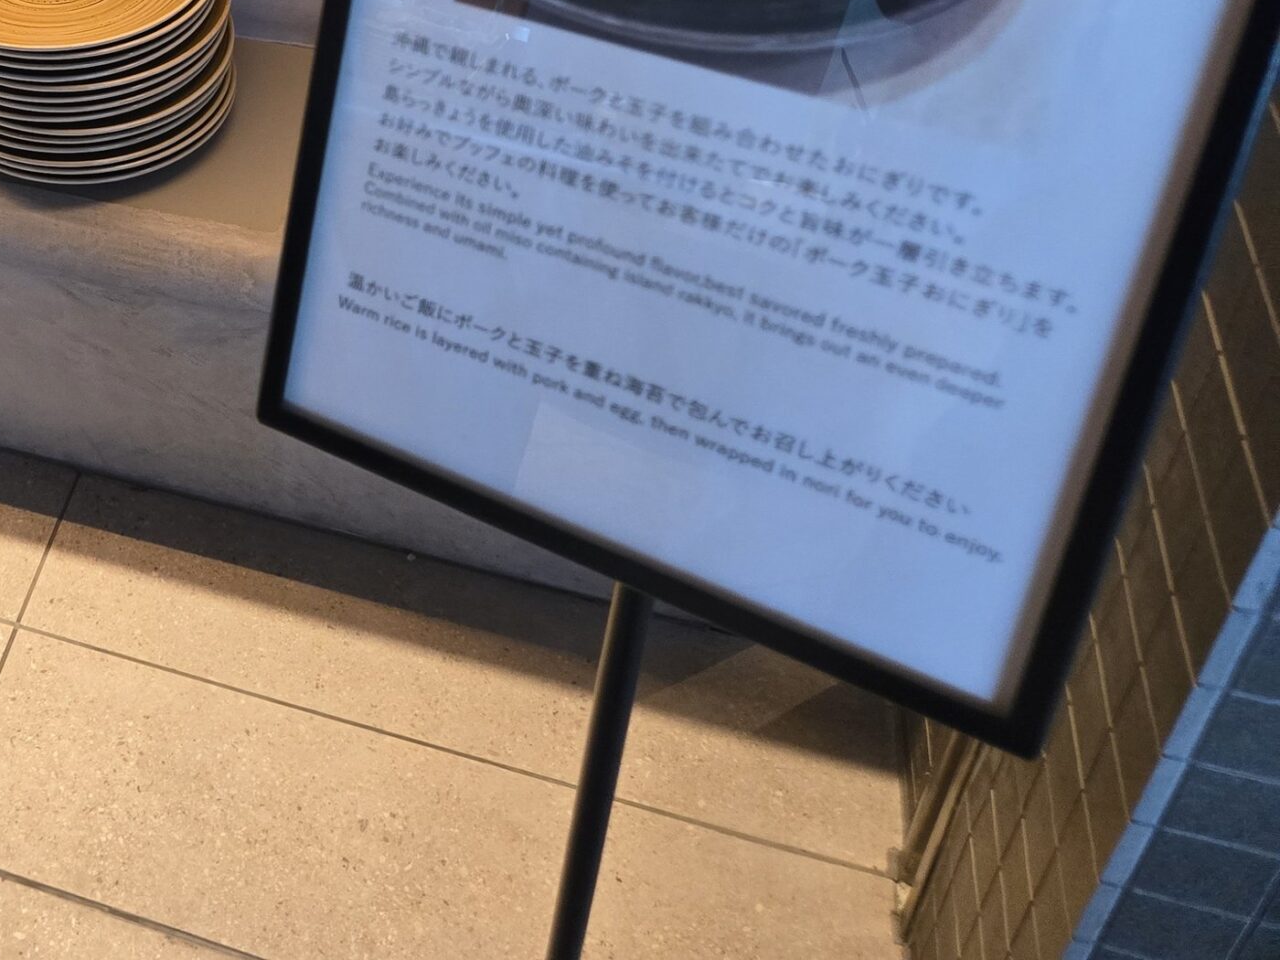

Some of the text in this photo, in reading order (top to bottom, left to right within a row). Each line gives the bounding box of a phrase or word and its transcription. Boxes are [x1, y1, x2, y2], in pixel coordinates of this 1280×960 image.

[373, 136, 517, 199] お楽しみください。
[422, 220, 451, 239] and
[476, 199, 532, 232] simple
[567, 228, 646, 268] profound
[830, 316, 898, 355] freshly
[336, 295, 380, 322] Warm
[383, 312, 411, 334] rice
[414, 324, 428, 340] is
[430, 330, 489, 365] layered
[491, 354, 528, 378] with
[531, 369, 569, 395] pork
[572, 385, 605, 408] and
[650, 415, 690, 441] then
[693, 431, 775, 475] wrapped
[778, 463, 797, 482] in
[801, 473, 838, 498] nori
[844, 489, 873, 512] for
[875, 502, 913, 529] you
[916, 517, 939, 538] to
[347, 271, 970, 520] 温かいご飯にポークと玉子を重ね海苔で包んでお召し上がりください
